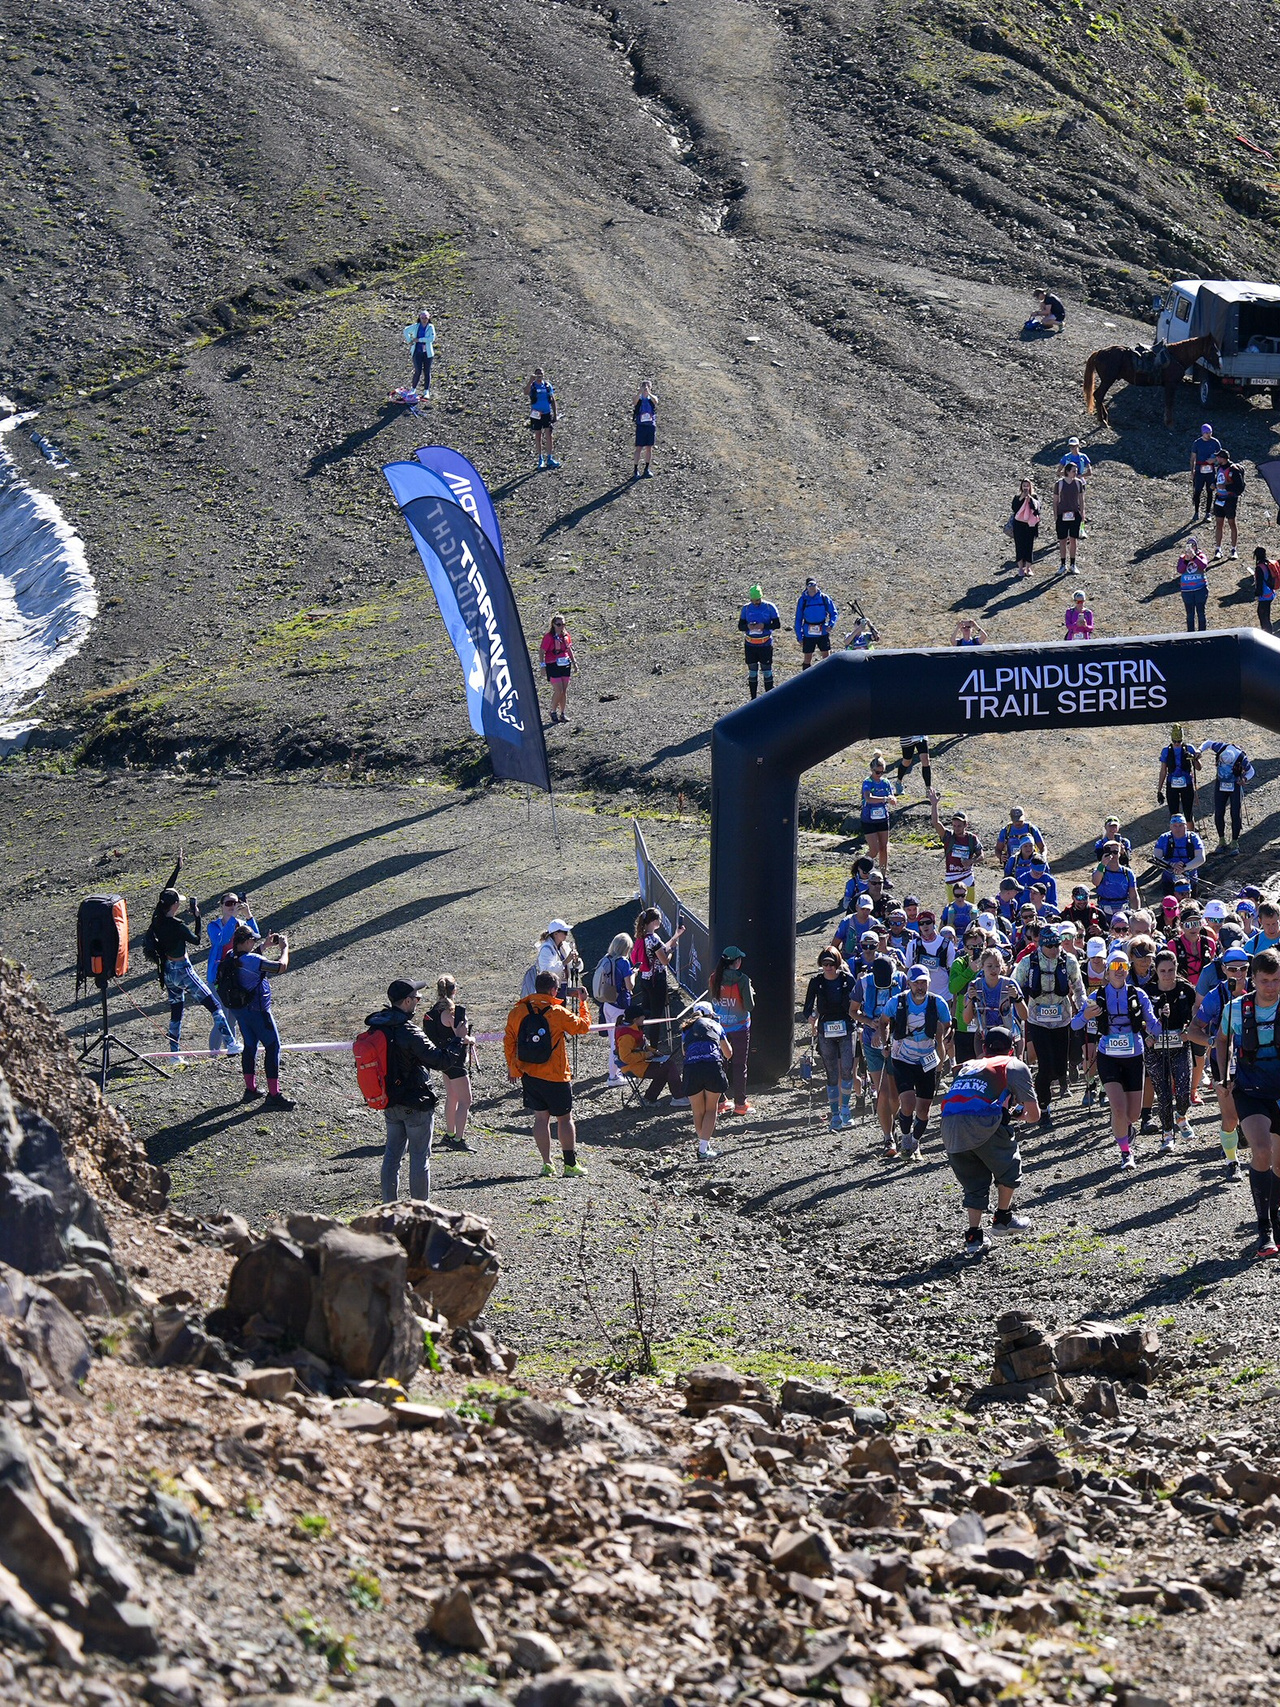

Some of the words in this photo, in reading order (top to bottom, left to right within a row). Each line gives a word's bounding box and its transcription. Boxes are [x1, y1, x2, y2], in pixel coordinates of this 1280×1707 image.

[958, 658, 1167, 693] ALPINDUSTRIA
[958, 692, 1050, 720] TRAIL
[1057, 684, 1168, 715] SERIES
[1109, 1039, 1129, 1047] 1065
